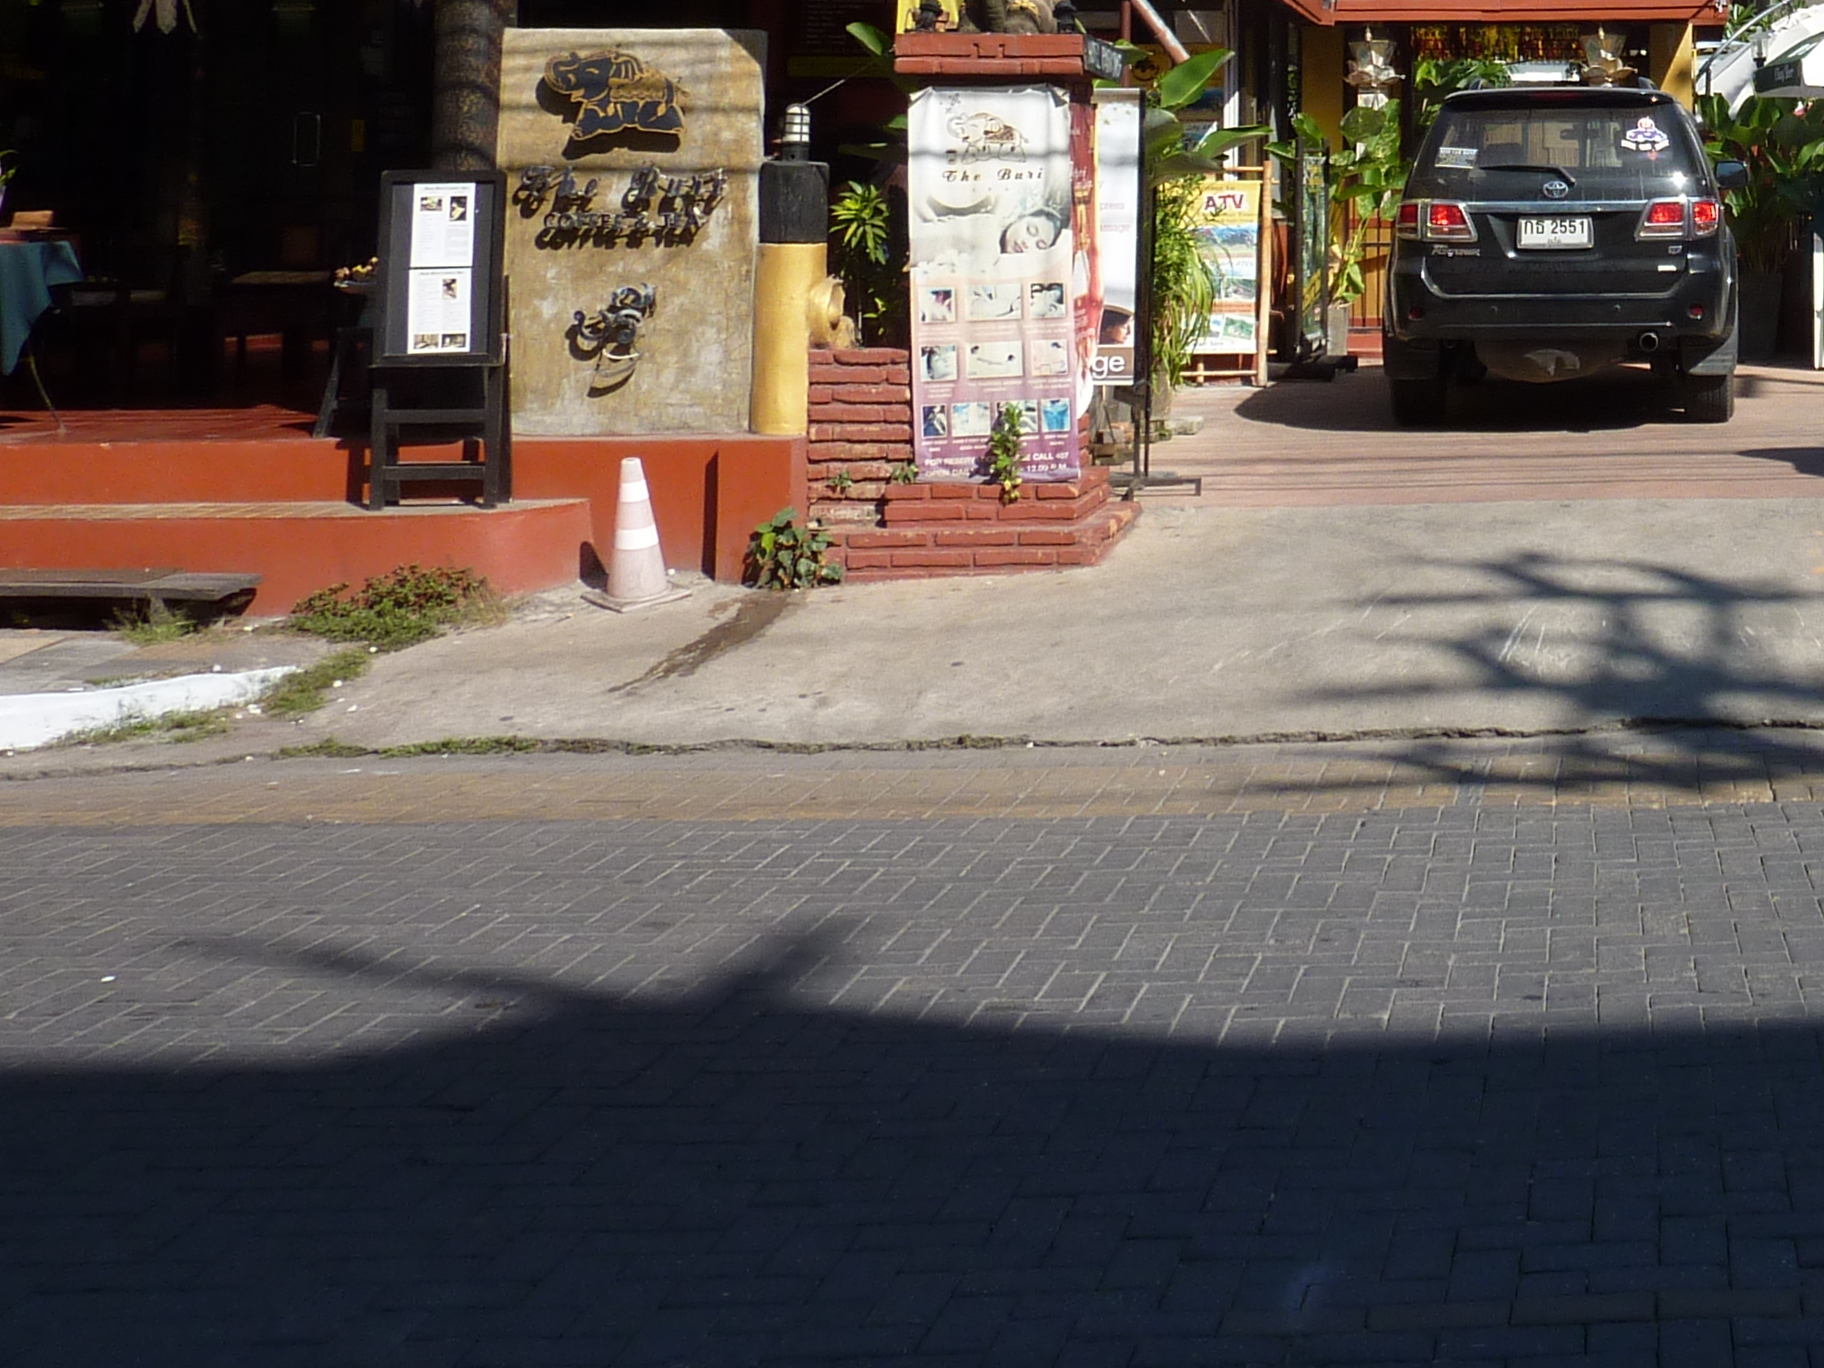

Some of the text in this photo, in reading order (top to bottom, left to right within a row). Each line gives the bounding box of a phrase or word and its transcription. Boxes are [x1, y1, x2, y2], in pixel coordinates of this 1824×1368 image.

[520, 166, 599, 199] The
[942, 167, 1044, 182] The Buri
[1204, 193, 1244, 211] ATV
[543, 212, 627, 229] COFFEE
[1550, 219, 1585, 235] 2551
[1032, 451, 1054, 462] CALL
[951, 468, 971, 478] DAIL
